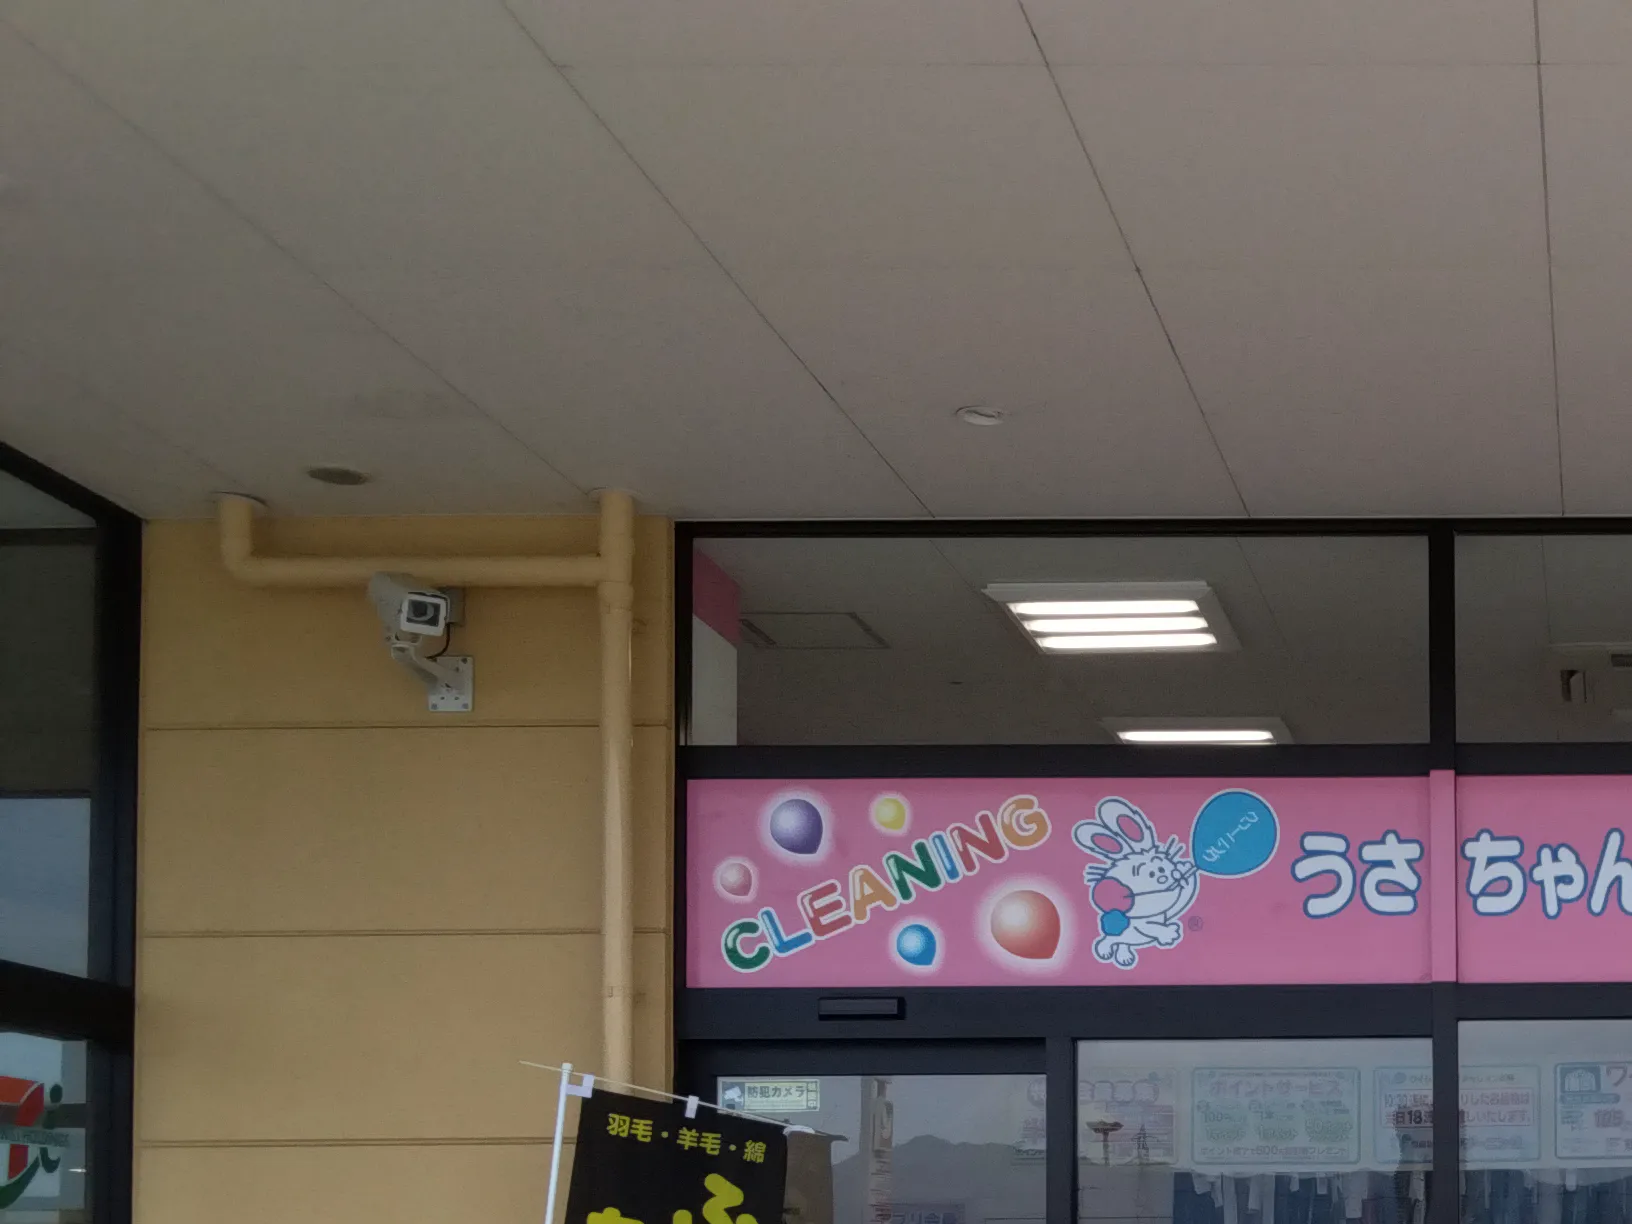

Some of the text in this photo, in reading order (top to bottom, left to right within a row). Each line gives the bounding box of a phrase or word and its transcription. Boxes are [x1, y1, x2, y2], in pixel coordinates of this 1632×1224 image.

[721, 794, 1052, 973] CLEANING
[747, 1085, 806, 1099] 防犯カメラ
[606, 1113, 767, 1163] 羽毛・羊毛・綿
